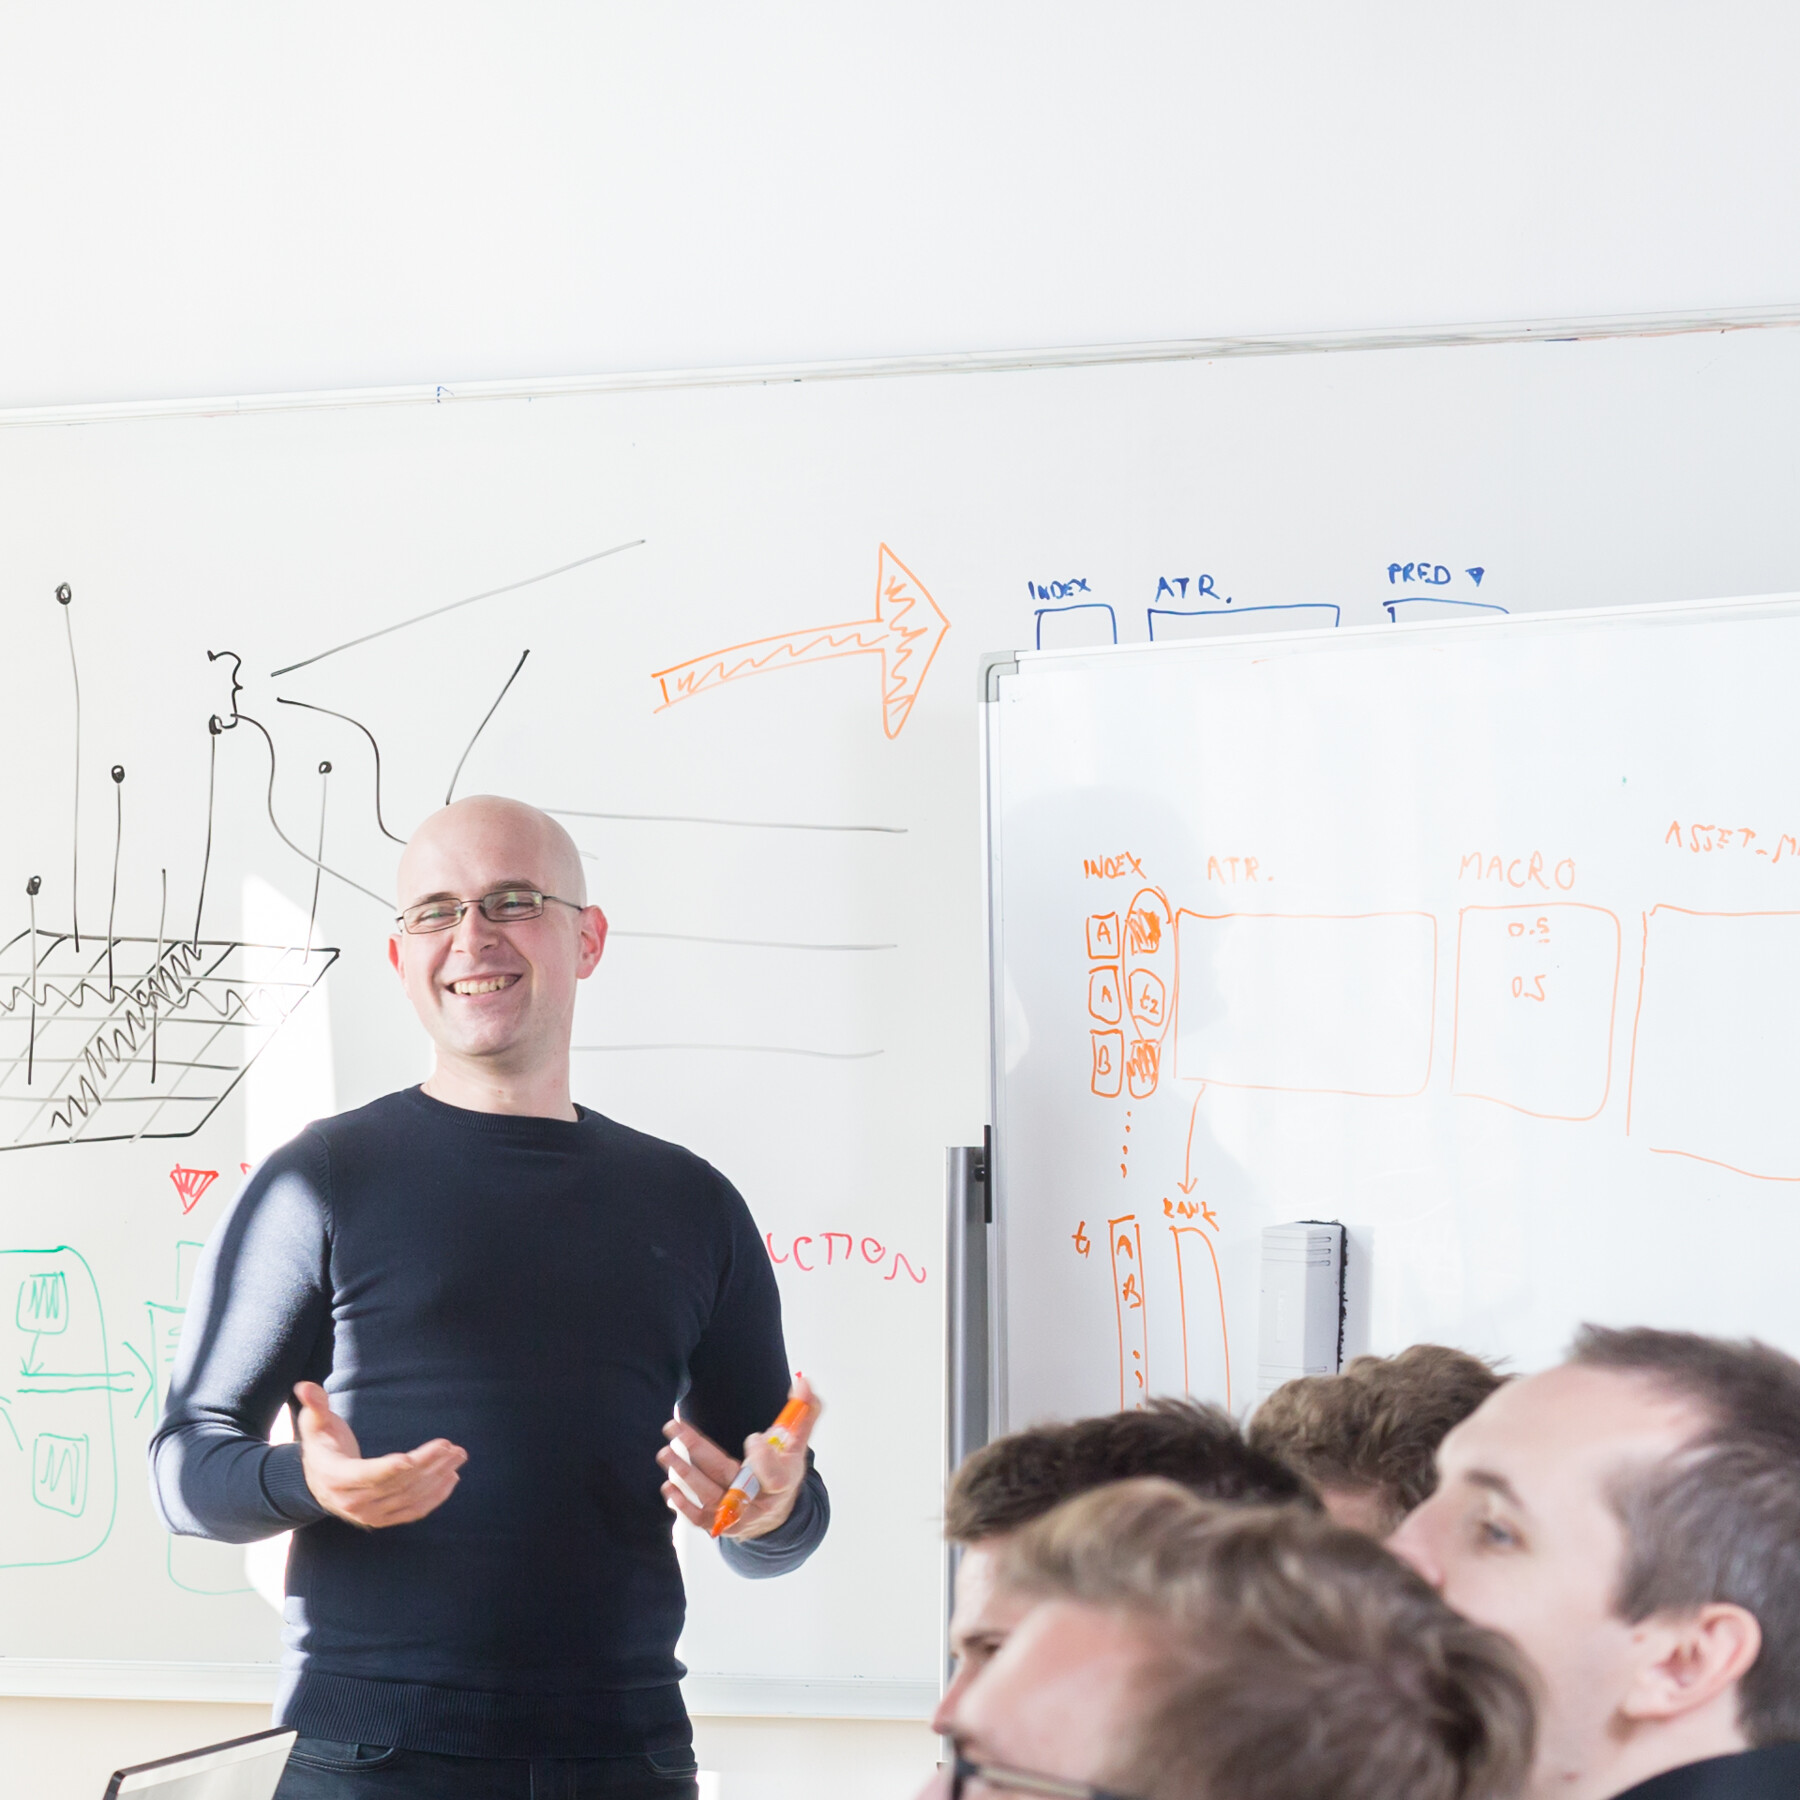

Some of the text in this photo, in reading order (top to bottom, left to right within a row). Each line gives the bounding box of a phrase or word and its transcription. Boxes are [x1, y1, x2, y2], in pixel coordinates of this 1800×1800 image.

[1028, 561, 1452, 604] INDEX ATR. PRED
[1083, 850, 1147, 880] INDEX
[1207, 855, 1274, 885] ATR.
[1458, 850, 1576, 891] MACRO
[1096, 921, 1113, 946] A
[1507, 916, 1551, 944] 0.5
[765, 1231, 928, 1284] UCTION
